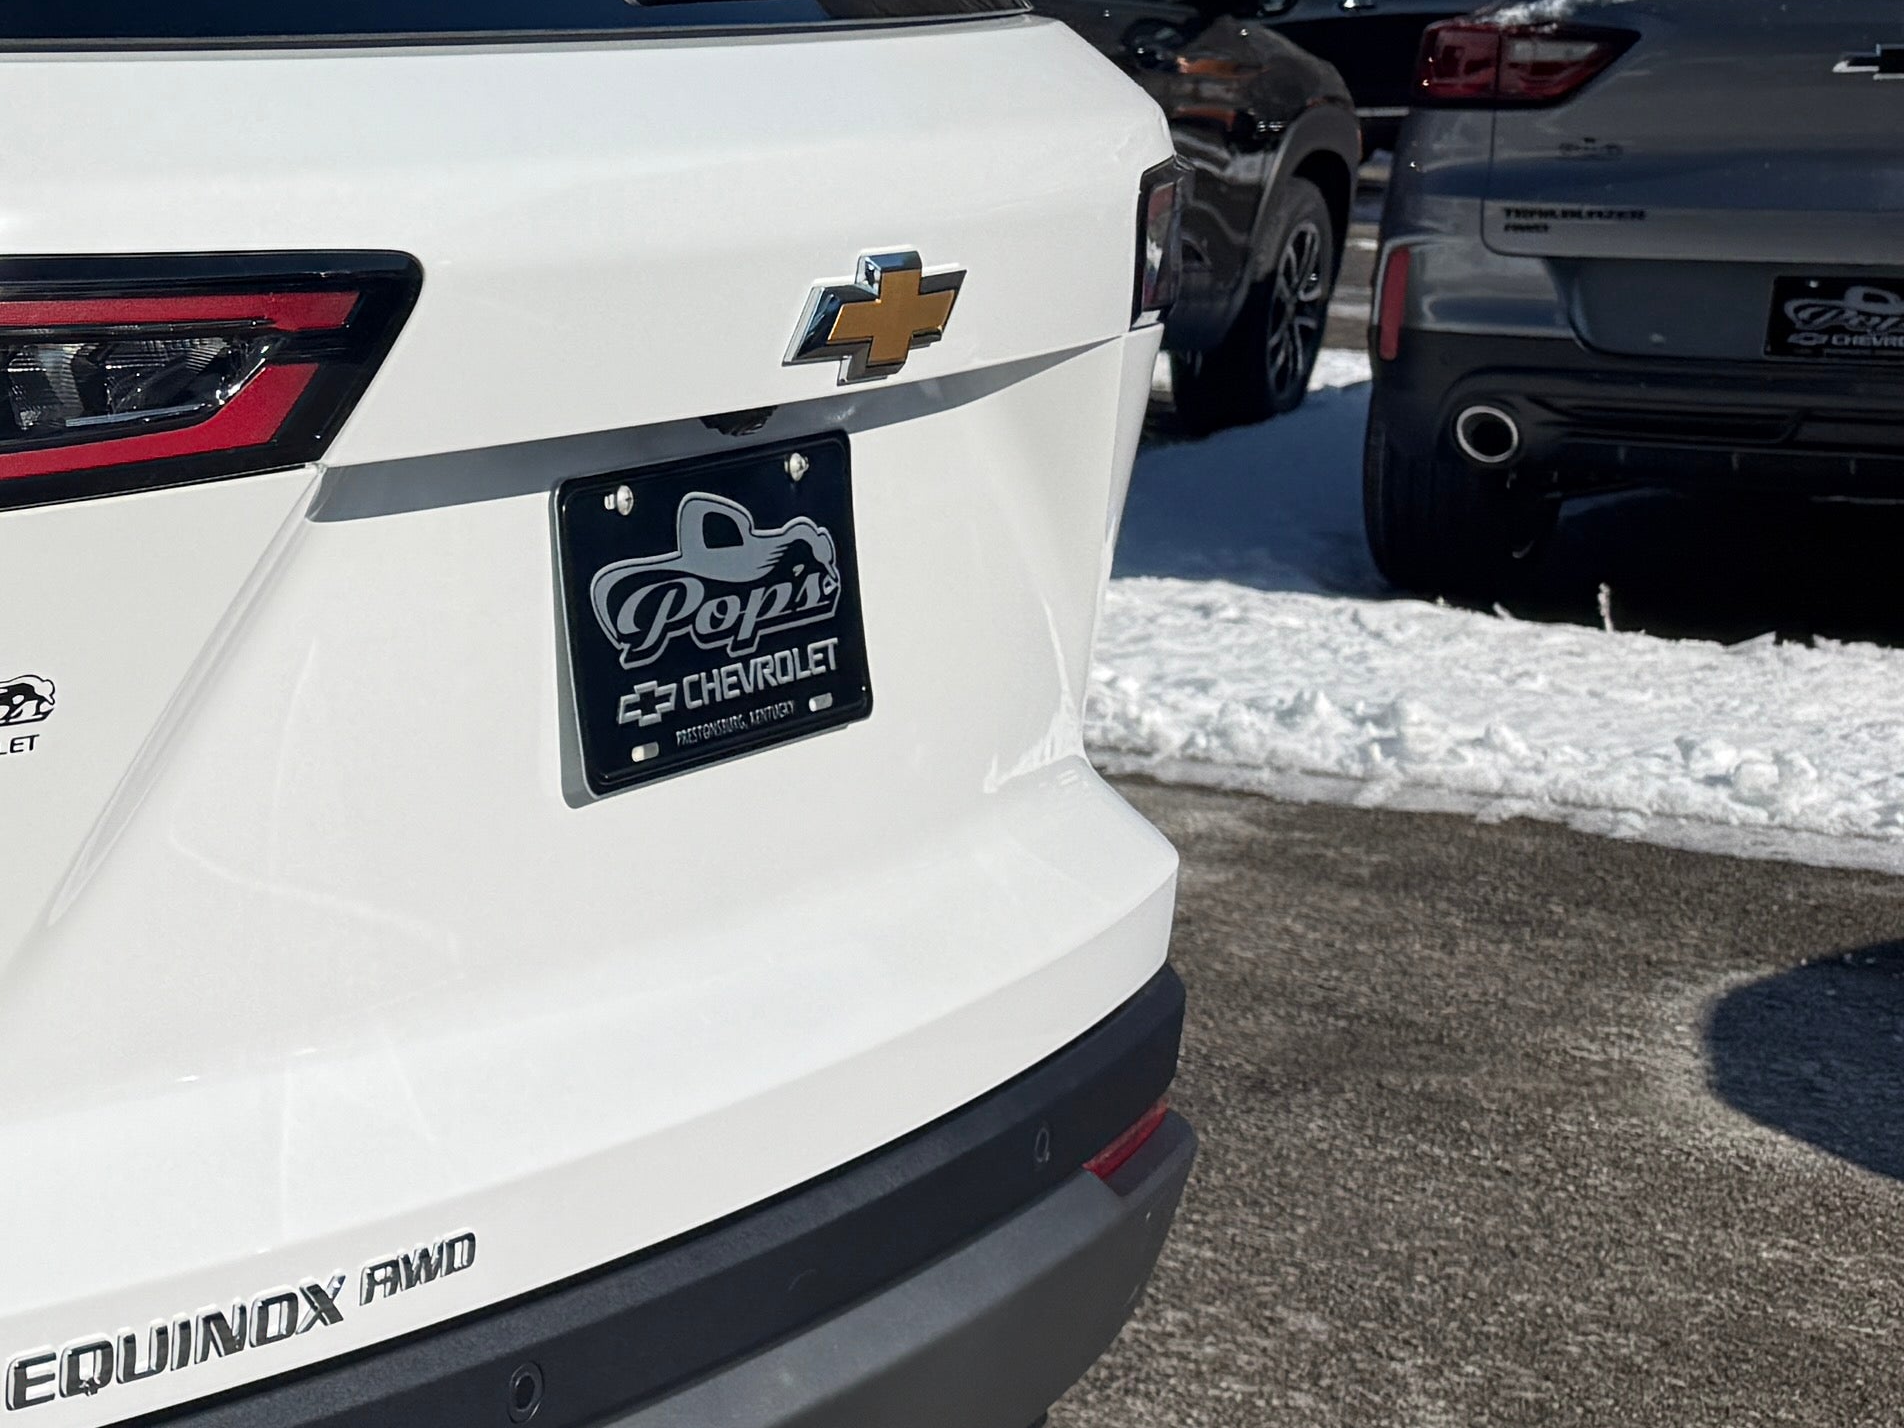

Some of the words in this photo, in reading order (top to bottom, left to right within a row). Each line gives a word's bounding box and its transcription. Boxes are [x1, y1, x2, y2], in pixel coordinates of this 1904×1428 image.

[616, 562, 841, 652] Pop's
[682, 637, 839, 710] CHEVROLET
[5, 1268, 347, 1411] EQUINOX
[358, 1227, 477, 1307] AWD
